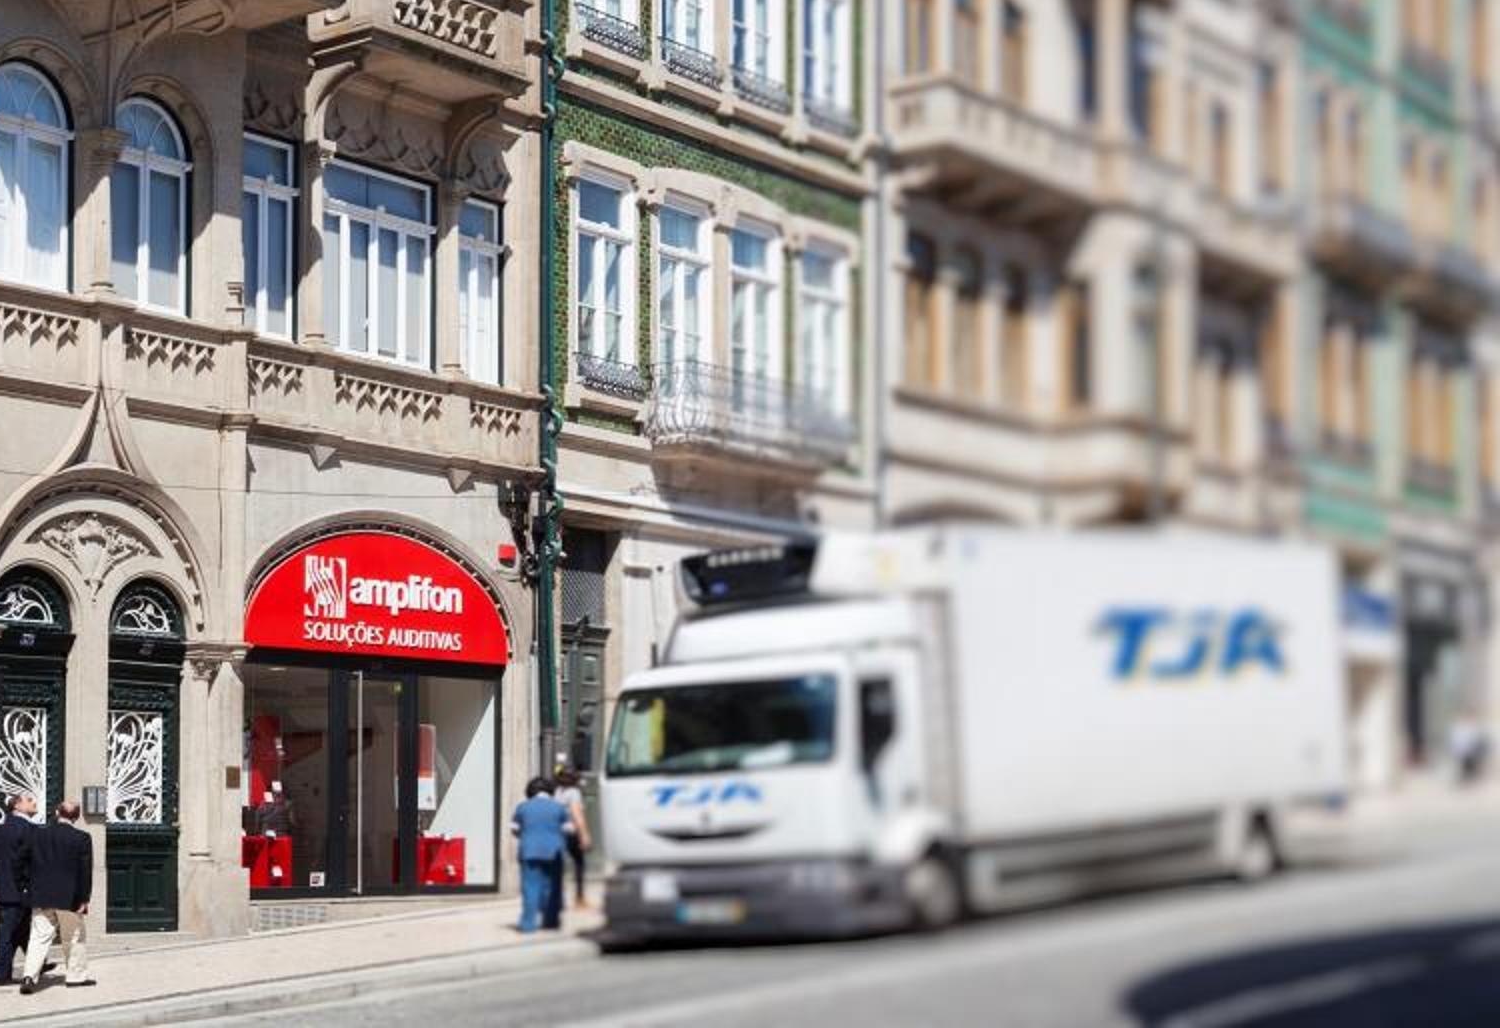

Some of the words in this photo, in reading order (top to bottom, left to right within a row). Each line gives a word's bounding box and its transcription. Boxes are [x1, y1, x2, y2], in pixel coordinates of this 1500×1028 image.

[350, 574, 463, 616] amplifon
[303, 621, 385, 648] SOLUÇÕES
[387, 627, 463, 651] AUDITIVAS
[1093, 603, 1289, 680] TJA
[653, 781, 763, 807] TJA
